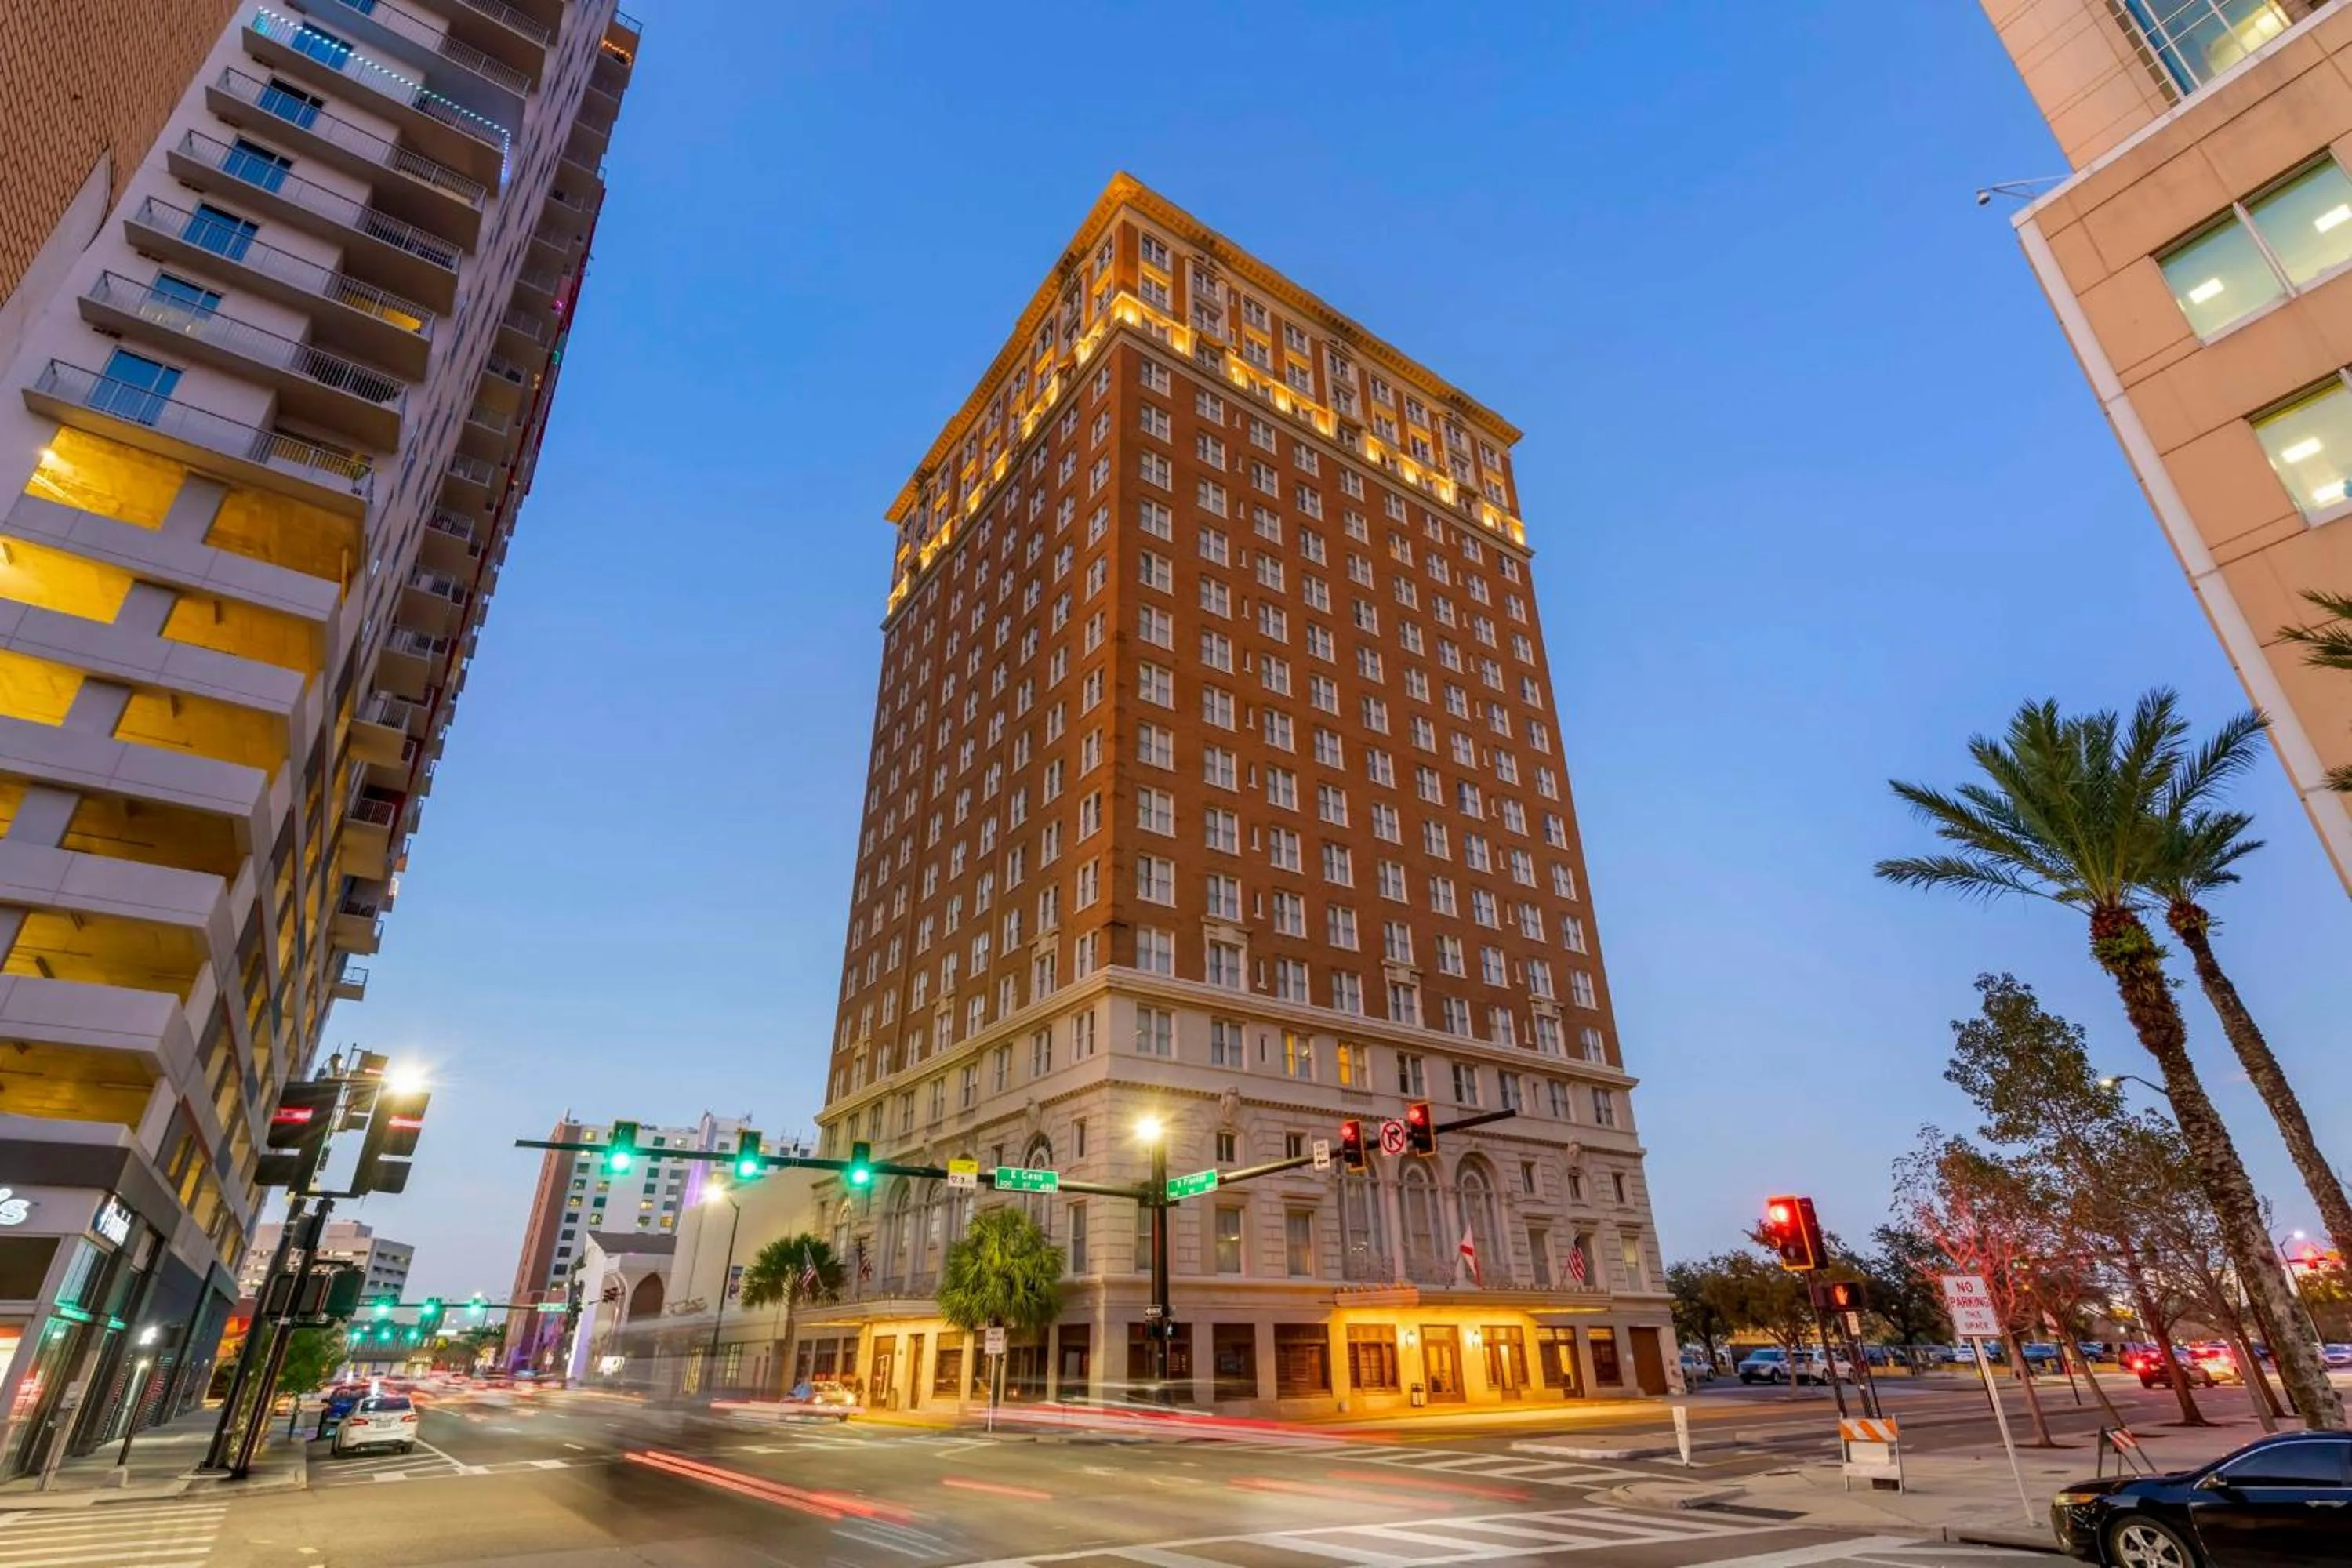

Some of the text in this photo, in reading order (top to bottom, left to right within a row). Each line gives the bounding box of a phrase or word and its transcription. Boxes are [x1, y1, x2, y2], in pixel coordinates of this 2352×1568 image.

[1022, 1171, 1043, 1181] Cass
[1956, 1281, 1973, 1293] NO
[1949, 1295, 1991, 1308] PARKING
